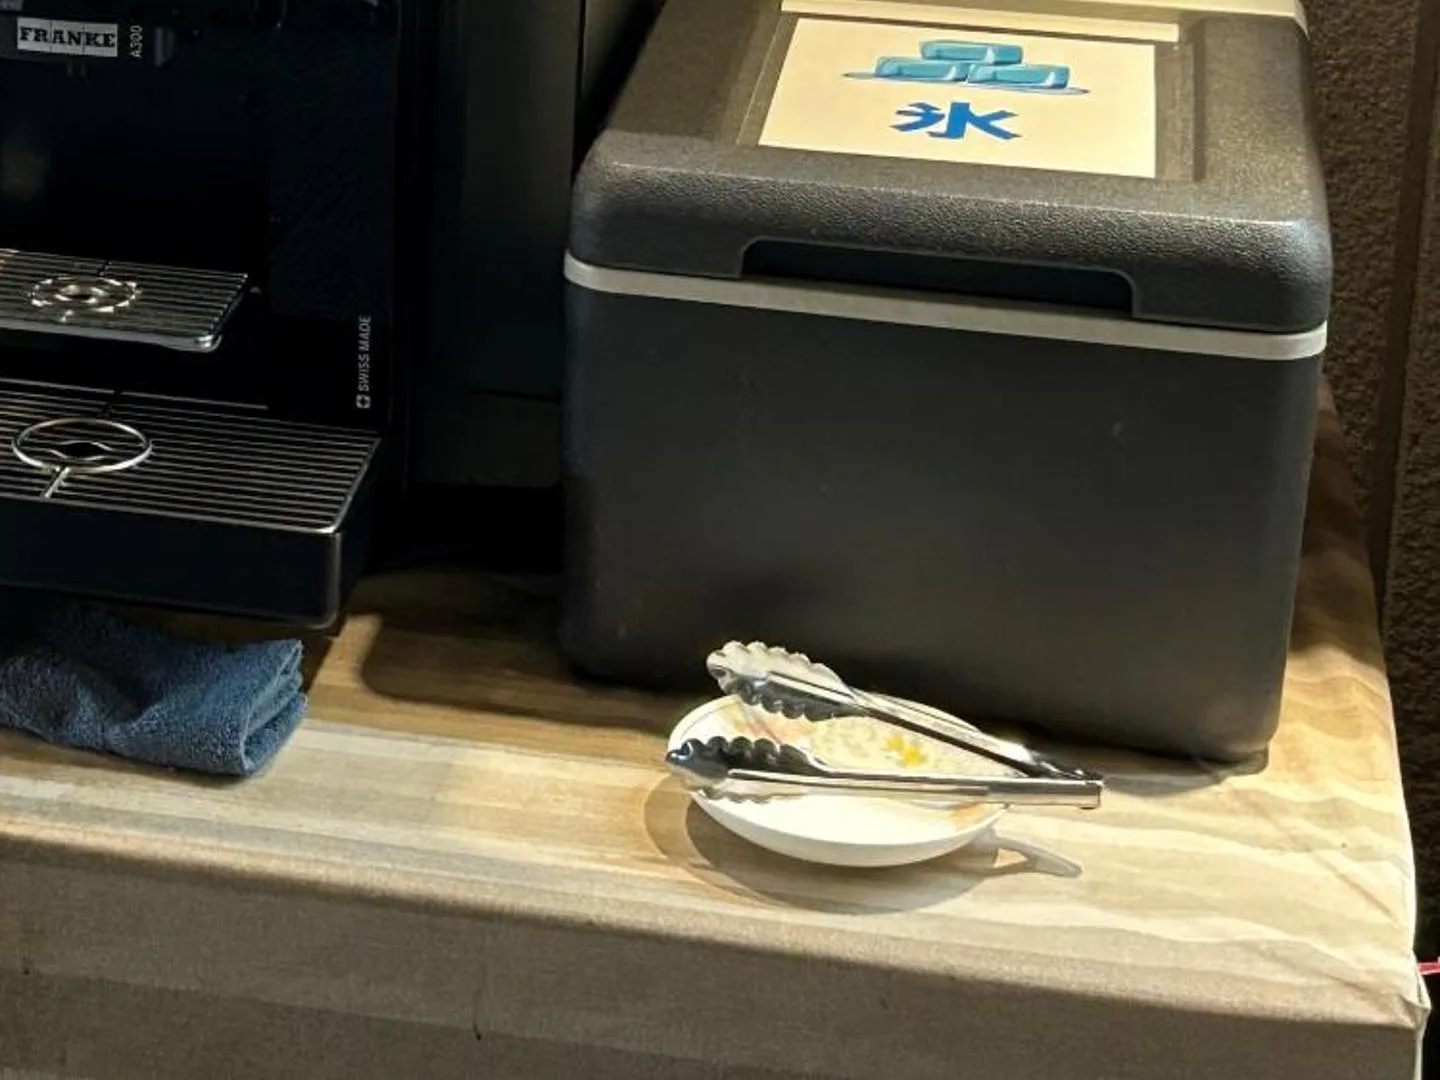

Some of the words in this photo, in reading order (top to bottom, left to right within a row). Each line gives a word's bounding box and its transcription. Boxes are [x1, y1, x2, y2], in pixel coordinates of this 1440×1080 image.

[19, 26, 116, 47] FRANKE
[891, 101, 1020, 140] 氷
[358, 315, 371, 351] MADE
[358, 353, 370, 392] SWISS
